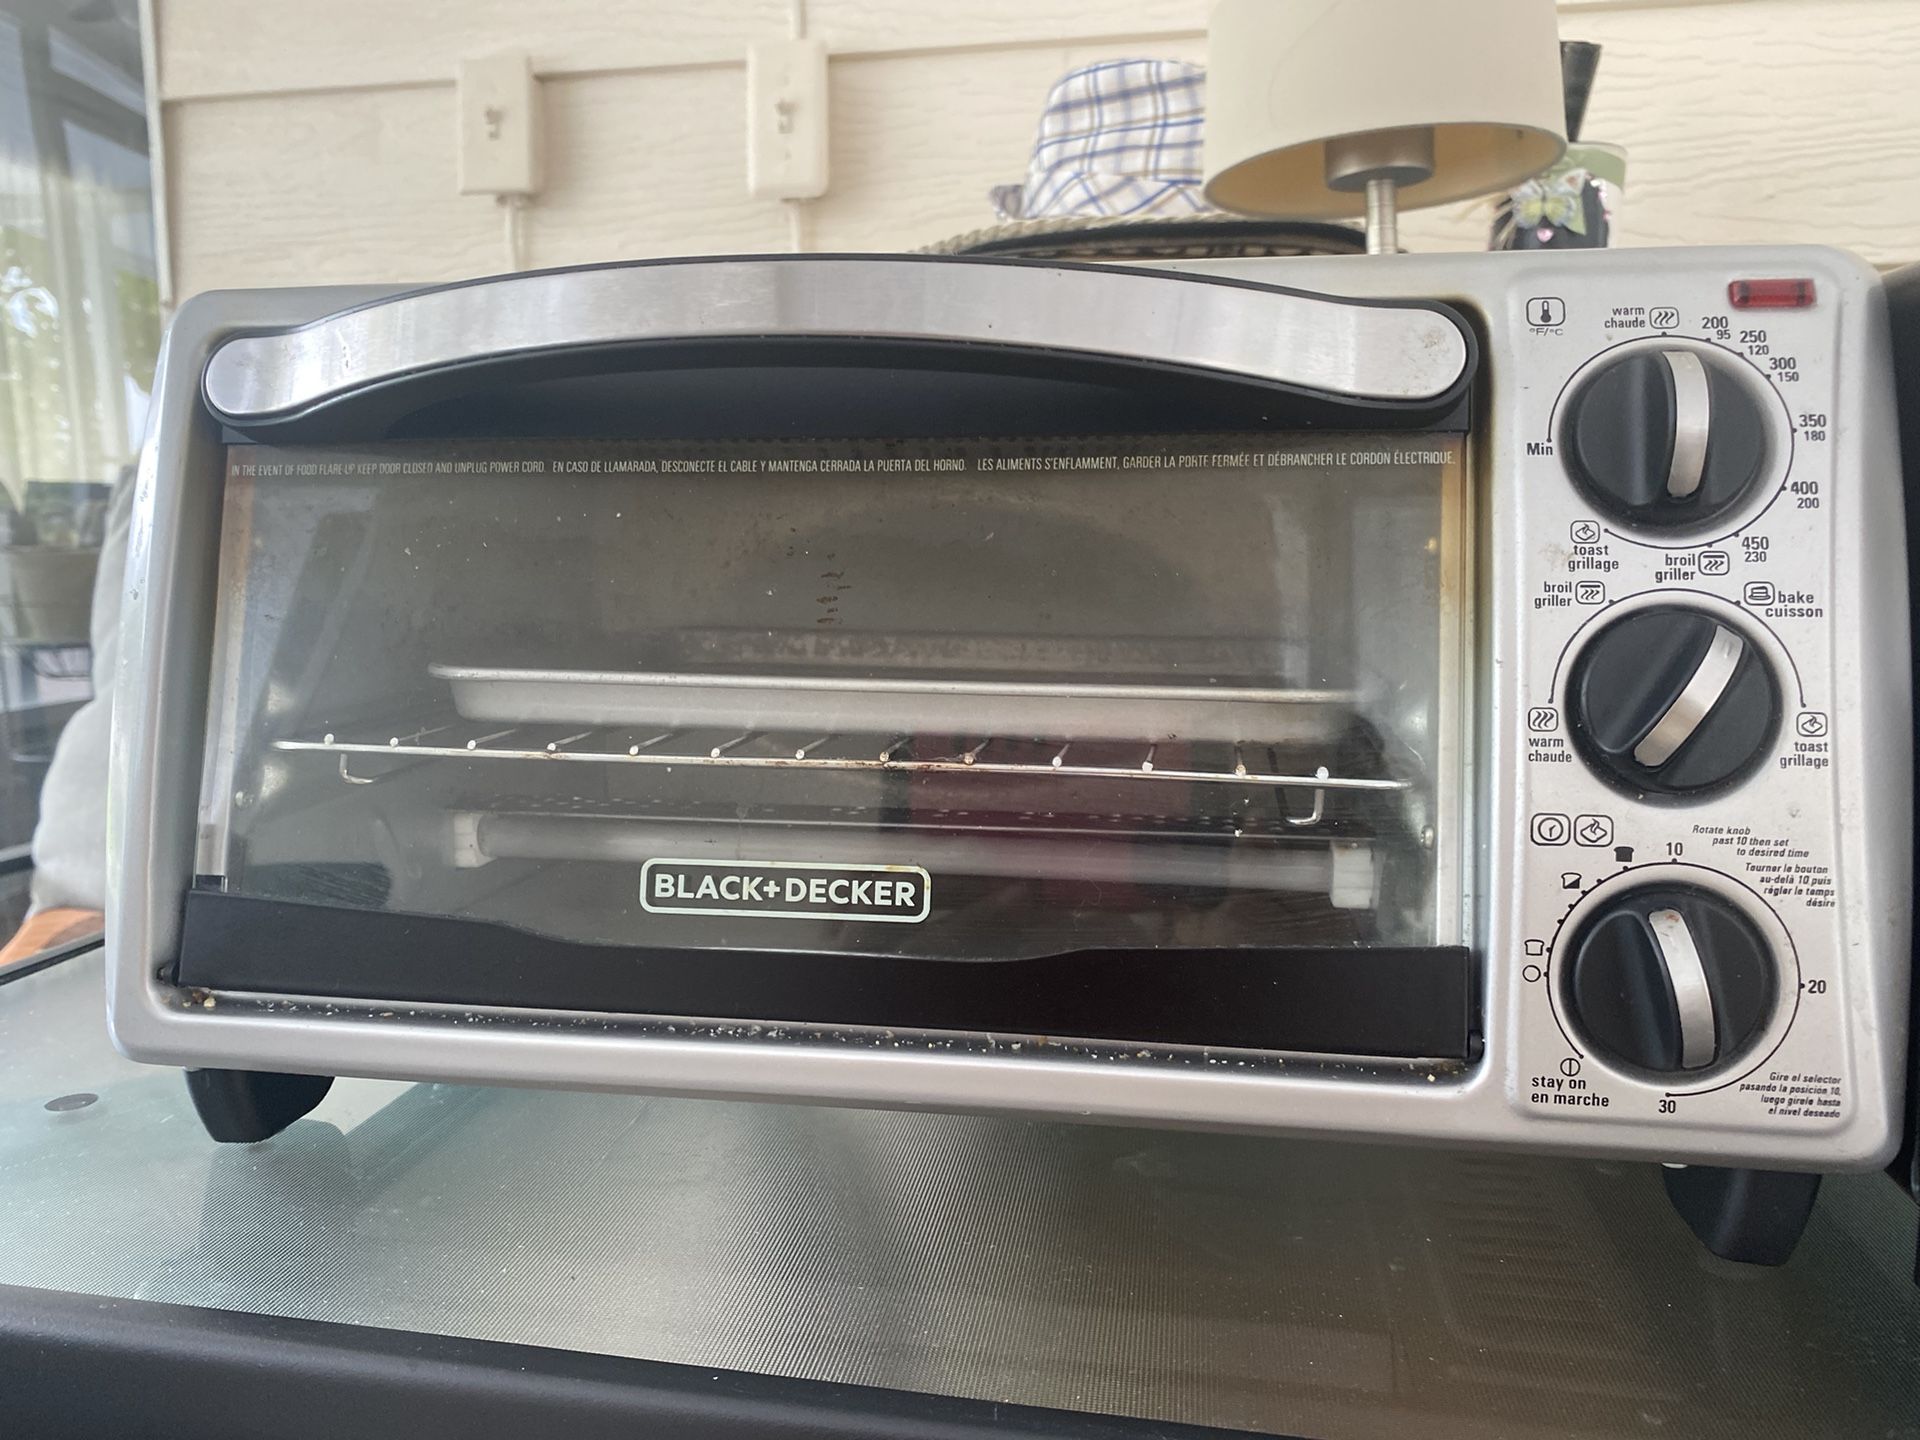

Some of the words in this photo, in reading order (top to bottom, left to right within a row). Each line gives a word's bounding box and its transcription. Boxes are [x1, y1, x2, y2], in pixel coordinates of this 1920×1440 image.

[1612, 307, 1645, 316] warm
[1604, 318, 1646, 329] chaude
[1702, 317, 1729, 329] 200
[1716, 329, 1731, 340] 95
[1740, 331, 1767, 343] 250
[1748, 345, 1769, 355] 120
[1769, 358, 1796, 370] 300
[1779, 372, 1799, 382] 150
[1799, 415, 1827, 428] 350
[1804, 431, 1826, 442] 180
[1526, 443, 1554, 456] Min
[552, 461, 564, 473] EN
[566, 461, 589, 473] CASO
[590, 461, 601, 473] DE
[604, 461, 659, 474] LLAMARADA,
[661, 460, 715, 473] DESCONECTE
[718, 460, 728, 473] EL
[730, 460, 757, 473] CABLE
[760, 460, 767, 472] Y
[768, 460, 818, 472] MANTENGA
[820, 460, 861, 472] CERRADA
[863, 460, 875, 472] LA
[877, 460, 912, 472] PUERTA
[914, 460, 931, 471] DEL
[933, 459, 967, 471] HORNO.
[977, 459, 994, 470] LES
[996, 458, 1042, 470] ALIMENTS
[1123, 456, 1161, 469] GARDER
[1164, 456, 1176, 468] LA
[1178, 455, 1208, 467] PORTE
[1212, 452, 1249, 467] FERMÉE
[1253, 454, 1264, 466] ET
[1267, 451, 1333, 466] DÉBRANCHER
[1336, 453, 1347, 465] LE
[1350, 452, 1391, 465] CORDON
[232, 465, 240, 476] IN
[242, 465, 256, 476] THE
[258, 464, 283, 476] EVENT
[285, 464, 295, 475] OF
[297, 464, 317, 475] FOOD
[357, 463, 377, 474] KEEP
[379, 462, 401, 474] DOOR
[402, 462, 433, 474] CLOSED
[435, 462, 452, 473] AND
[454, 461, 488, 473] UNPLUG
[489, 461, 520, 473] POWER
[521, 461, 546, 473] CORD.
[1791, 482, 1818, 494] 400
[1797, 498, 1819, 509] 200
[1742, 537, 1769, 550] 450
[1574, 545, 1609, 556] toast
[1665, 554, 1696, 567] broil
[1745, 552, 1767, 563] 230
[1568, 558, 1619, 571] grillage
[1655, 568, 1696, 582] griller
[1544, 582, 1572, 594] broil
[1534, 595, 1572, 608] griller
[1778, 591, 1814, 604] bake
[1765, 606, 1823, 618] cuisson
[1529, 738, 1564, 748] warm
[1794, 741, 1829, 753] toast
[1528, 751, 1572, 763] chaude
[1780, 755, 1829, 768] grillage
[1692, 825, 1724, 835] Rotate
[1726, 826, 1751, 836] knob
[1712, 837, 1734, 847] past
[1736, 836, 1748, 845] 10
[1749, 837, 1771, 846] then
[1773, 839, 1790, 847] set
[1666, 843, 1684, 856] 10
[1736, 848, 1746, 856] to
[1748, 848, 1786, 858] desired
[1787, 848, 1810, 858] time
[1745, 863, 1782, 873] Tourner
[1783, 864, 1792, 873] le
[1794, 865, 1829, 874] bouton
[1798, 876, 1810, 885] 10
[1811, 877, 1832, 887] puis
[654, 873, 916, 907] BLACK+DECKER
[1794, 886, 1803, 896] le
[1805, 888, 1835, 898] temps
[1807, 980, 1827, 994] 20
[1769, 1072, 1789, 1081] Gire
[1791, 1073, 1801, 1082] el
[1802, 1074, 1842, 1084] selector
[1531, 1076, 1563, 1093] stay
[1568, 1079, 1586, 1090] on
[1739, 1082, 1777, 1092] pasando
[1779, 1084, 1788, 1093] la
[1531, 1093, 1548, 1104] en
[1553, 1093, 1609, 1107] marche
[1760, 1094, 1786, 1105] luego
[1816, 1097, 1841, 1107] hasta
[1658, 1100, 1676, 1114] 30
[1768, 1106, 1777, 1115] el
[1778, 1107, 1801, 1116] nivel
[1803, 1108, 1841, 1118] deseado
